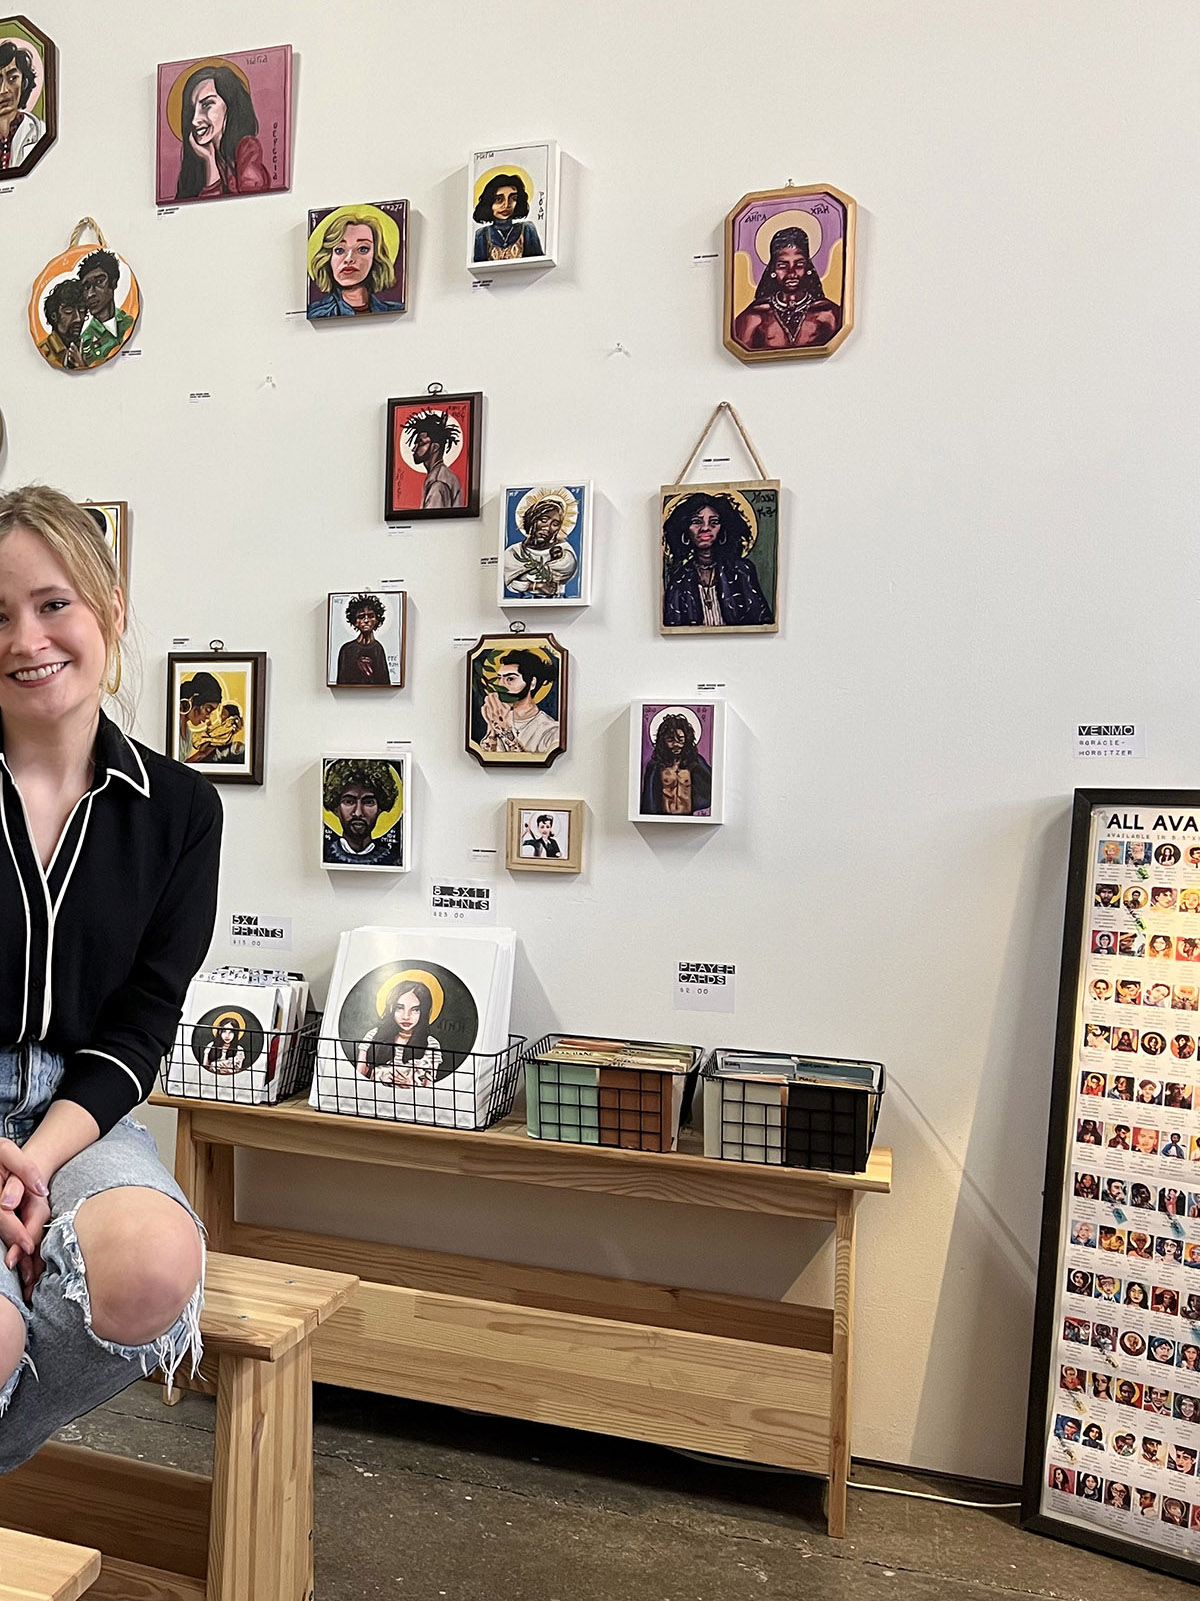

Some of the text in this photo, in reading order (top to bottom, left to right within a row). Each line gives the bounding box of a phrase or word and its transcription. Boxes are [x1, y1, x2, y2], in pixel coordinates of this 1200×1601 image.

[1078, 725, 1134, 736] VENMO
[1107, 813, 1199, 832] ALL AVA
[433, 897, 490, 910] PRINTS
[233, 915, 258, 925] 5X7
[232, 926, 283, 938] PRINTS
[679, 962, 735, 974] PRAYER
[679, 973, 726, 985] CARDS
